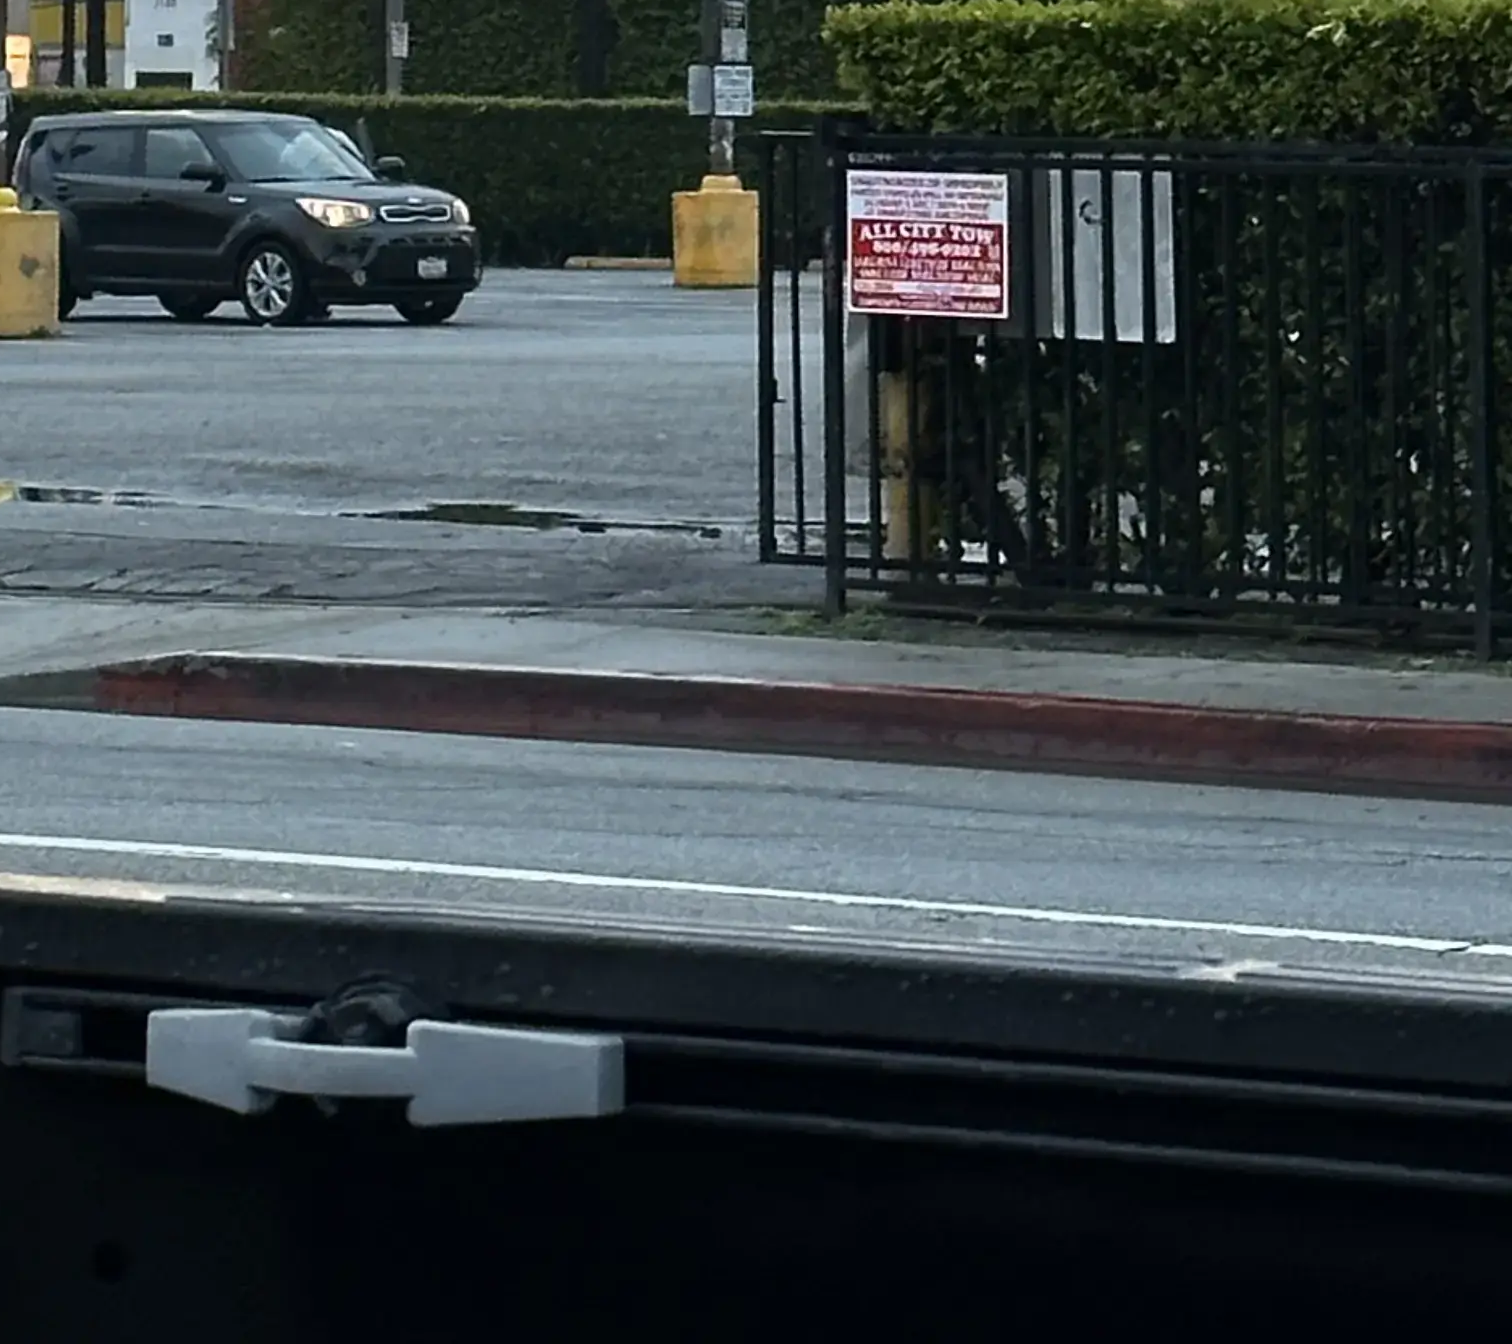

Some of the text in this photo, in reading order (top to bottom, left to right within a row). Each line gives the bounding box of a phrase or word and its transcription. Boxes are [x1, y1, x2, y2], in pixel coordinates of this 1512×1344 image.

[860, 223, 995, 244] ALL CITY TOW
